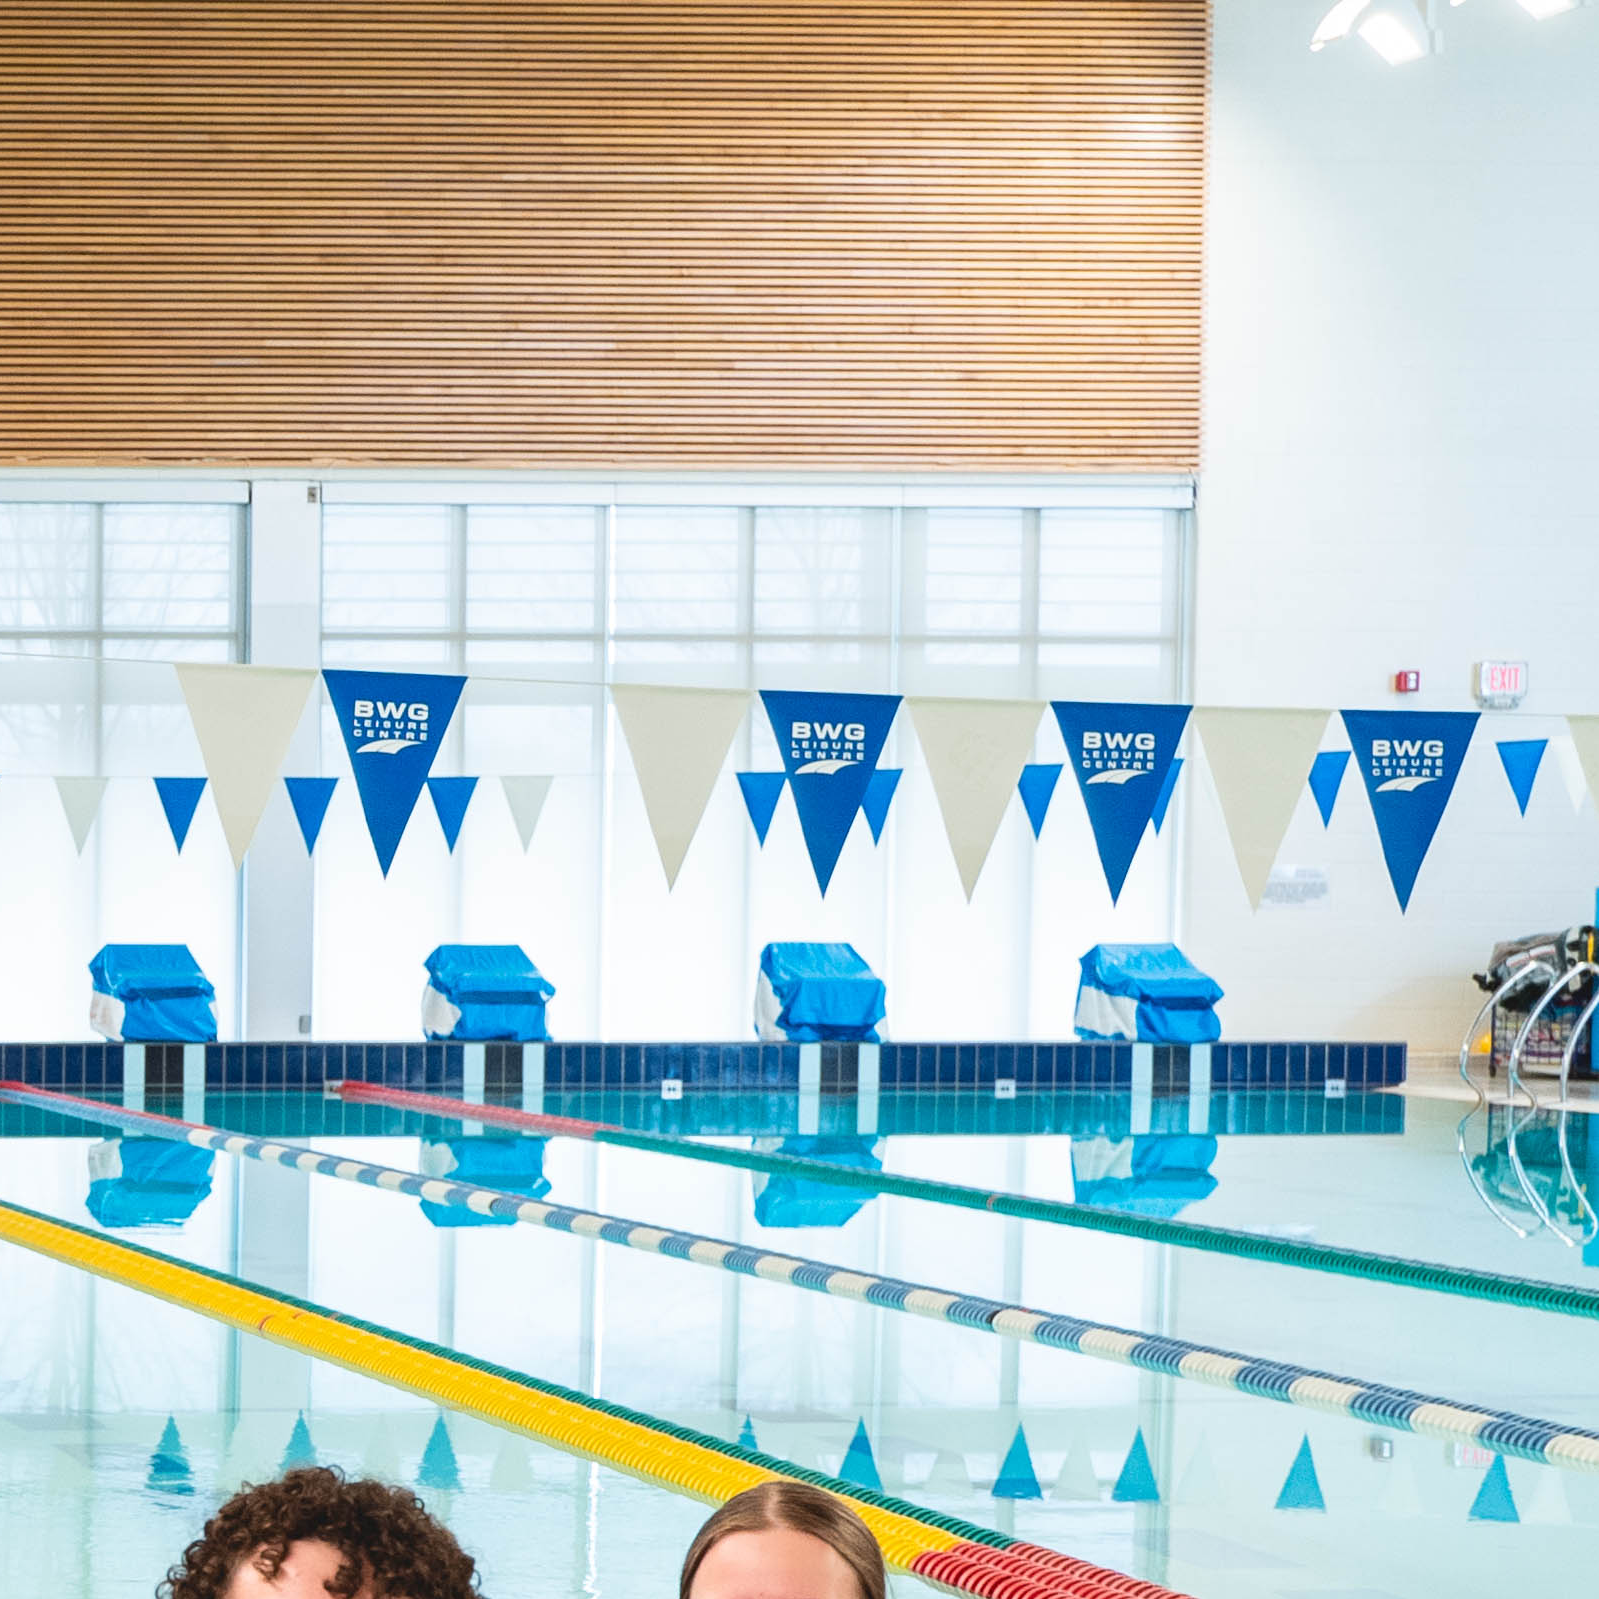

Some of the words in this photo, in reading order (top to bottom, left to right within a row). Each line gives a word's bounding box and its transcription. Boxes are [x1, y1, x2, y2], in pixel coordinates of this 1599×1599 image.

[1490, 666, 1521, 691] EXIT
[354, 699, 429, 721] BWG
[353, 718, 428, 731] LEISURE
[791, 721, 866, 741] BWG
[353, 728, 428, 741] CENTRE
[1082, 731, 1156, 751] BWG
[791, 740, 865, 751] LEISURE
[1371, 739, 1444, 758] BWG
[791, 750, 864, 761] CENTRE
[1082, 750, 1155, 761] LEISURE
[1082, 759, 1155, 771] CENTRE
[1371, 757, 1444, 768] LEISURE
[1371, 767, 1444, 777] CENTRE
